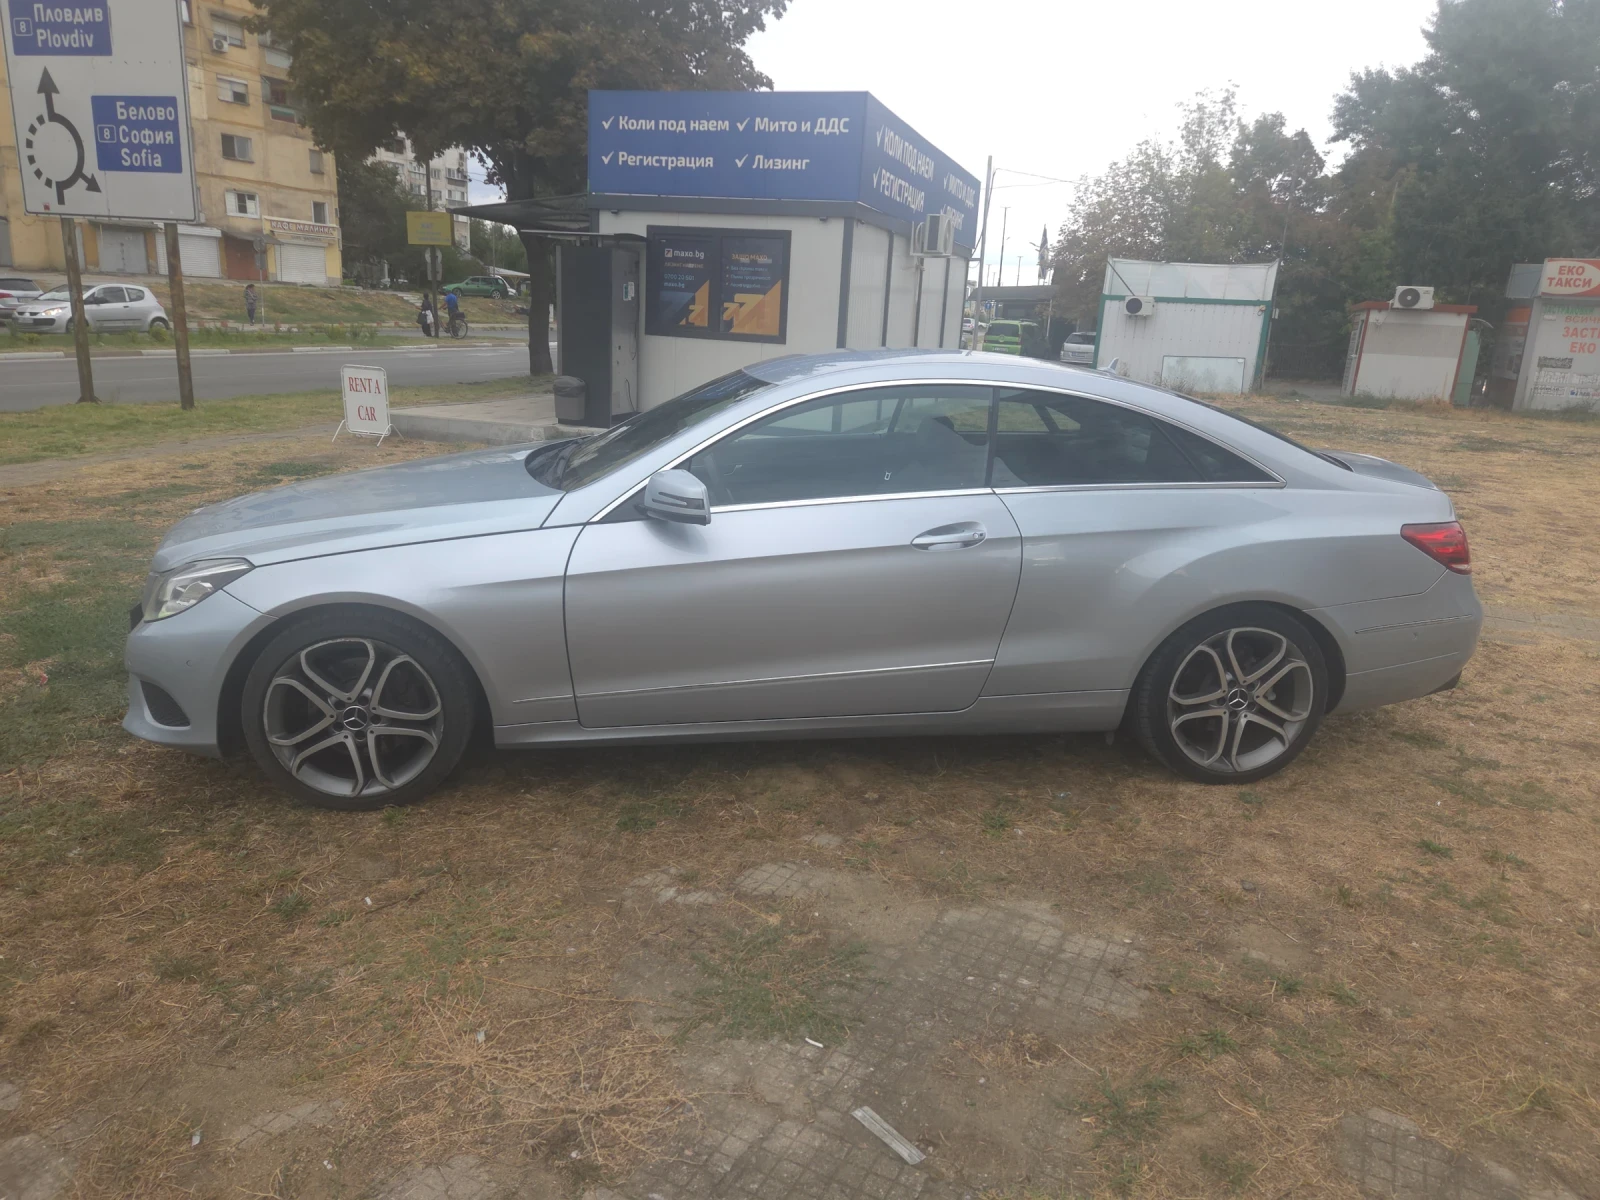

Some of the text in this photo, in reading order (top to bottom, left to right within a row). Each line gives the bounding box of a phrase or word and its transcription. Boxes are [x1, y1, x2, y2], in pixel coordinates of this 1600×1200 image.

[33, 3, 103, 25] Пловдив
[19, 21, 27, 33] 8
[36, 28, 94, 48] Plovdiv
[116, 101, 175, 121] Белово
[619, 115, 730, 134] Коли под наем
[754, 117, 850, 136] Мито и ДДС
[103, 125, 174, 146] 8 София
[121, 147, 163, 167] Sofia
[618, 151, 714, 171] Регистрация
[752, 154, 810, 170] Лизинг
[883, 125, 935, 182] КОЛИ ПОД НАЕМ
[880, 168, 925, 214] РЕГИСТРАЦИЯ
[271, 220, 333, 235] КАФЕ МАЛИНКА
[673, 249, 705, 260] maxo.bg
[1558, 265, 1586, 276] ЕКО
[1547, 276, 1593, 288] ТАКСИ
[1569, 341, 1597, 354] ЕКО
[348, 376, 381, 395] RENT A
[357, 405, 378, 422] CAR
